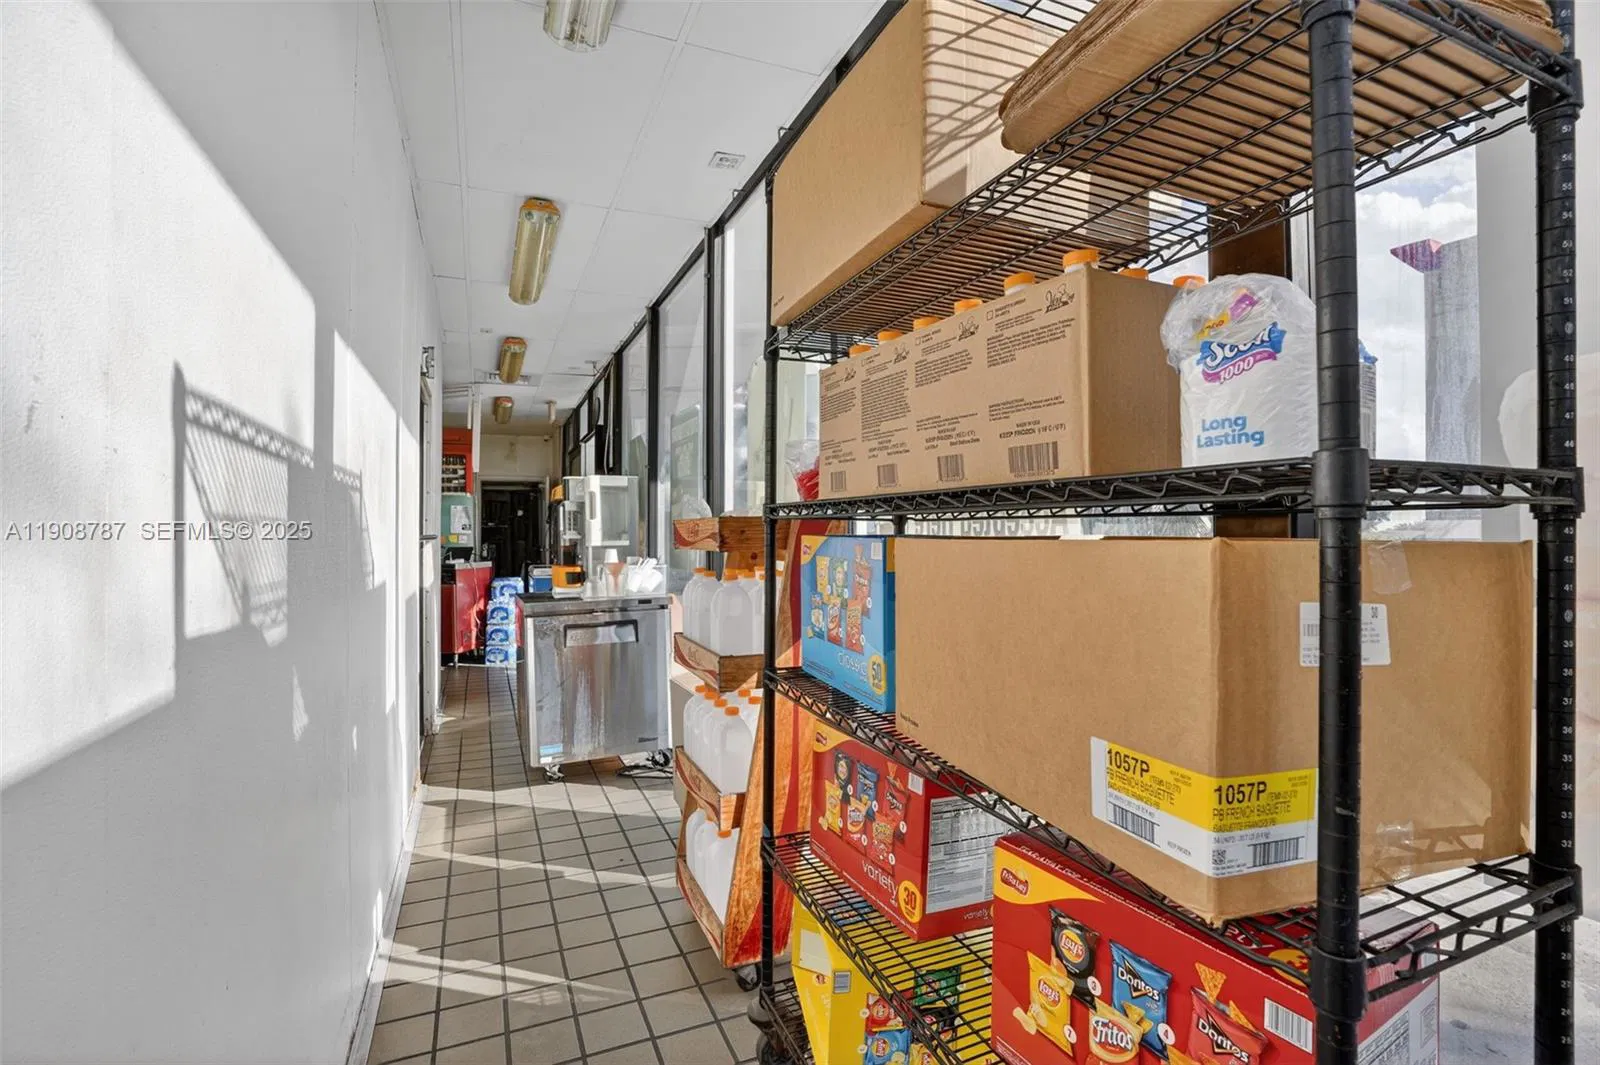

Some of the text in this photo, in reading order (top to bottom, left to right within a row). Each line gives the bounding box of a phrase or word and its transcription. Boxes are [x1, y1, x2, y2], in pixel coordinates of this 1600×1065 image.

[1220, 356, 1254, 384] 1000
[1201, 415, 1247, 432] Long
[1197, 429, 1265, 448] Lasting
[1107, 748, 1150, 778] 1057P
[1214, 781, 1267, 805] 1057P
[1226, 805, 1255, 820] FRENCH
[1256, 800, 1291, 817] BAGUETTE
[862, 860, 899, 899] variety
[903, 887, 917, 911] 30
[1062, 934, 1085, 957] Lay's
[1040, 979, 1060, 1003] Lay's
[1117, 966, 1160, 1001] Doritos
[1091, 1016, 1134, 1052] Fritos
[1198, 1018, 1250, 1064] Doritos
